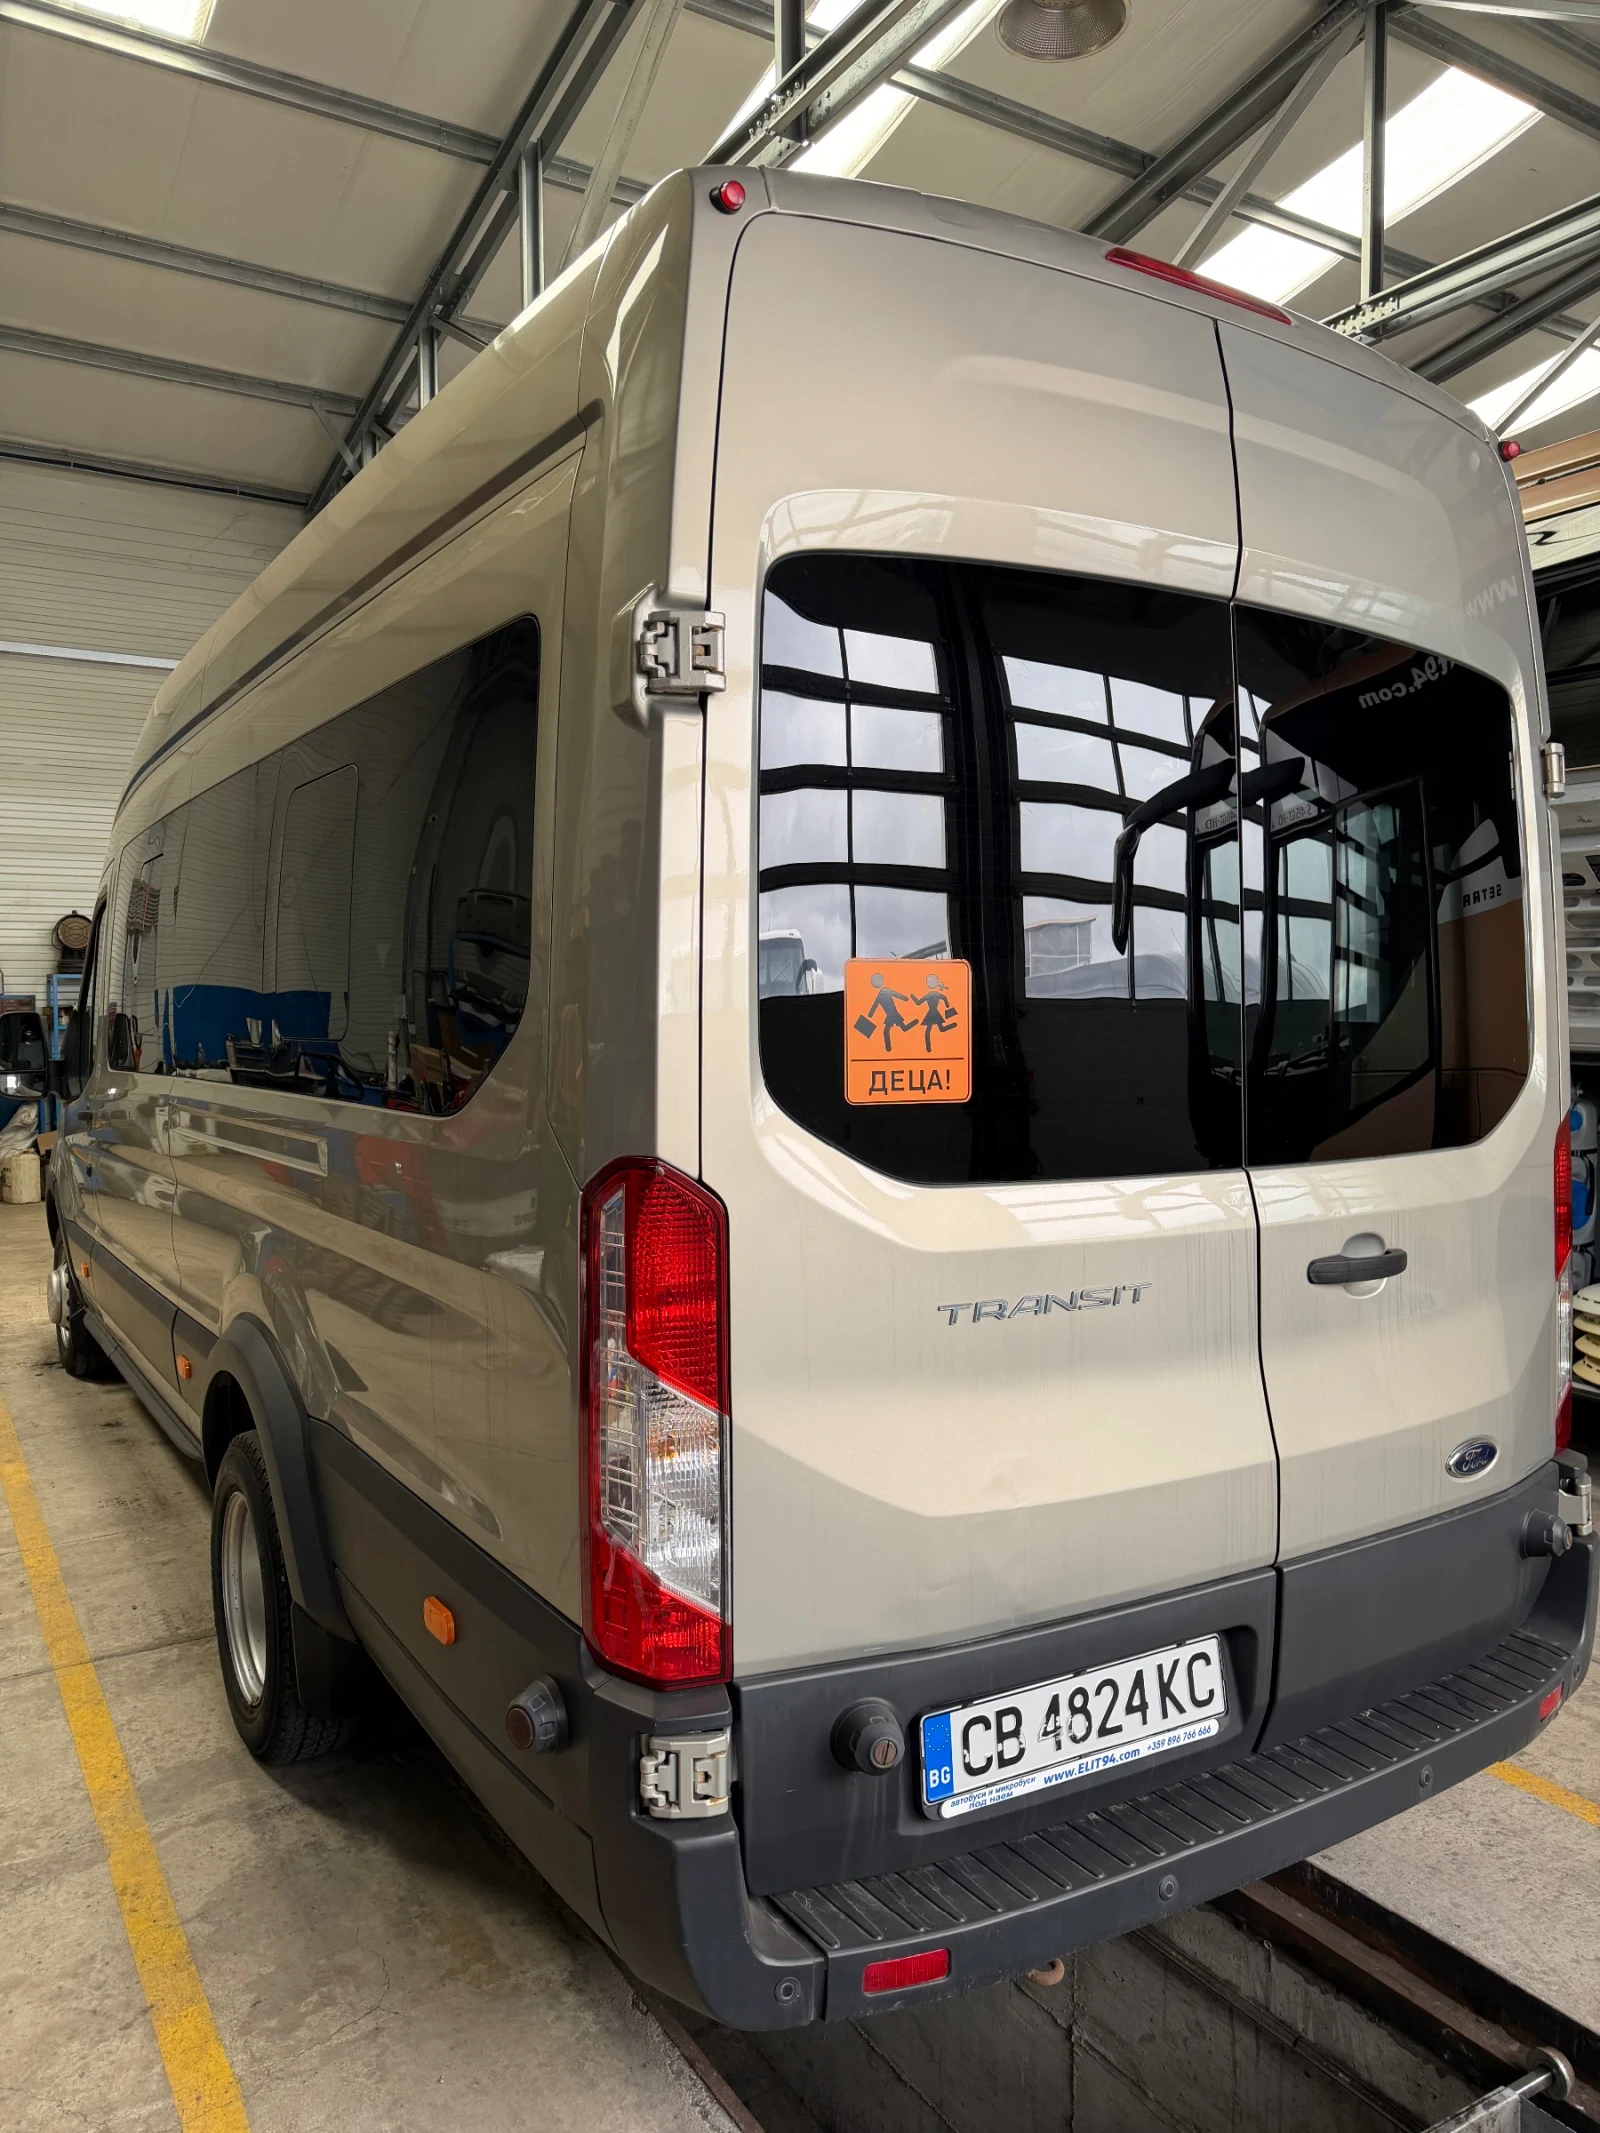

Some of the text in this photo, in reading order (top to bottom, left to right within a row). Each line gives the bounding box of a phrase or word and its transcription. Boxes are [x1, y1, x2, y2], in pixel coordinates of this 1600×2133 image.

[868, 1069, 951, 1096] ДЕЦА!
[937, 1281, 1153, 1326] TRANSIT
[1462, 1447, 1490, 1472] Ford
[1147, 1738, 1166, 1752] +359
[1167, 1734, 1181, 1746] 896
[1183, 1729, 1197, 1742] 766
[929, 1766, 951, 1788] BG
[1043, 1747, 1141, 1785] www.ELIT94.com
[950, 1791, 987, 1808] автобуси
[995, 1776, 1037, 1794] микробуси
[969, 1791, 1014, 1810] под наем
